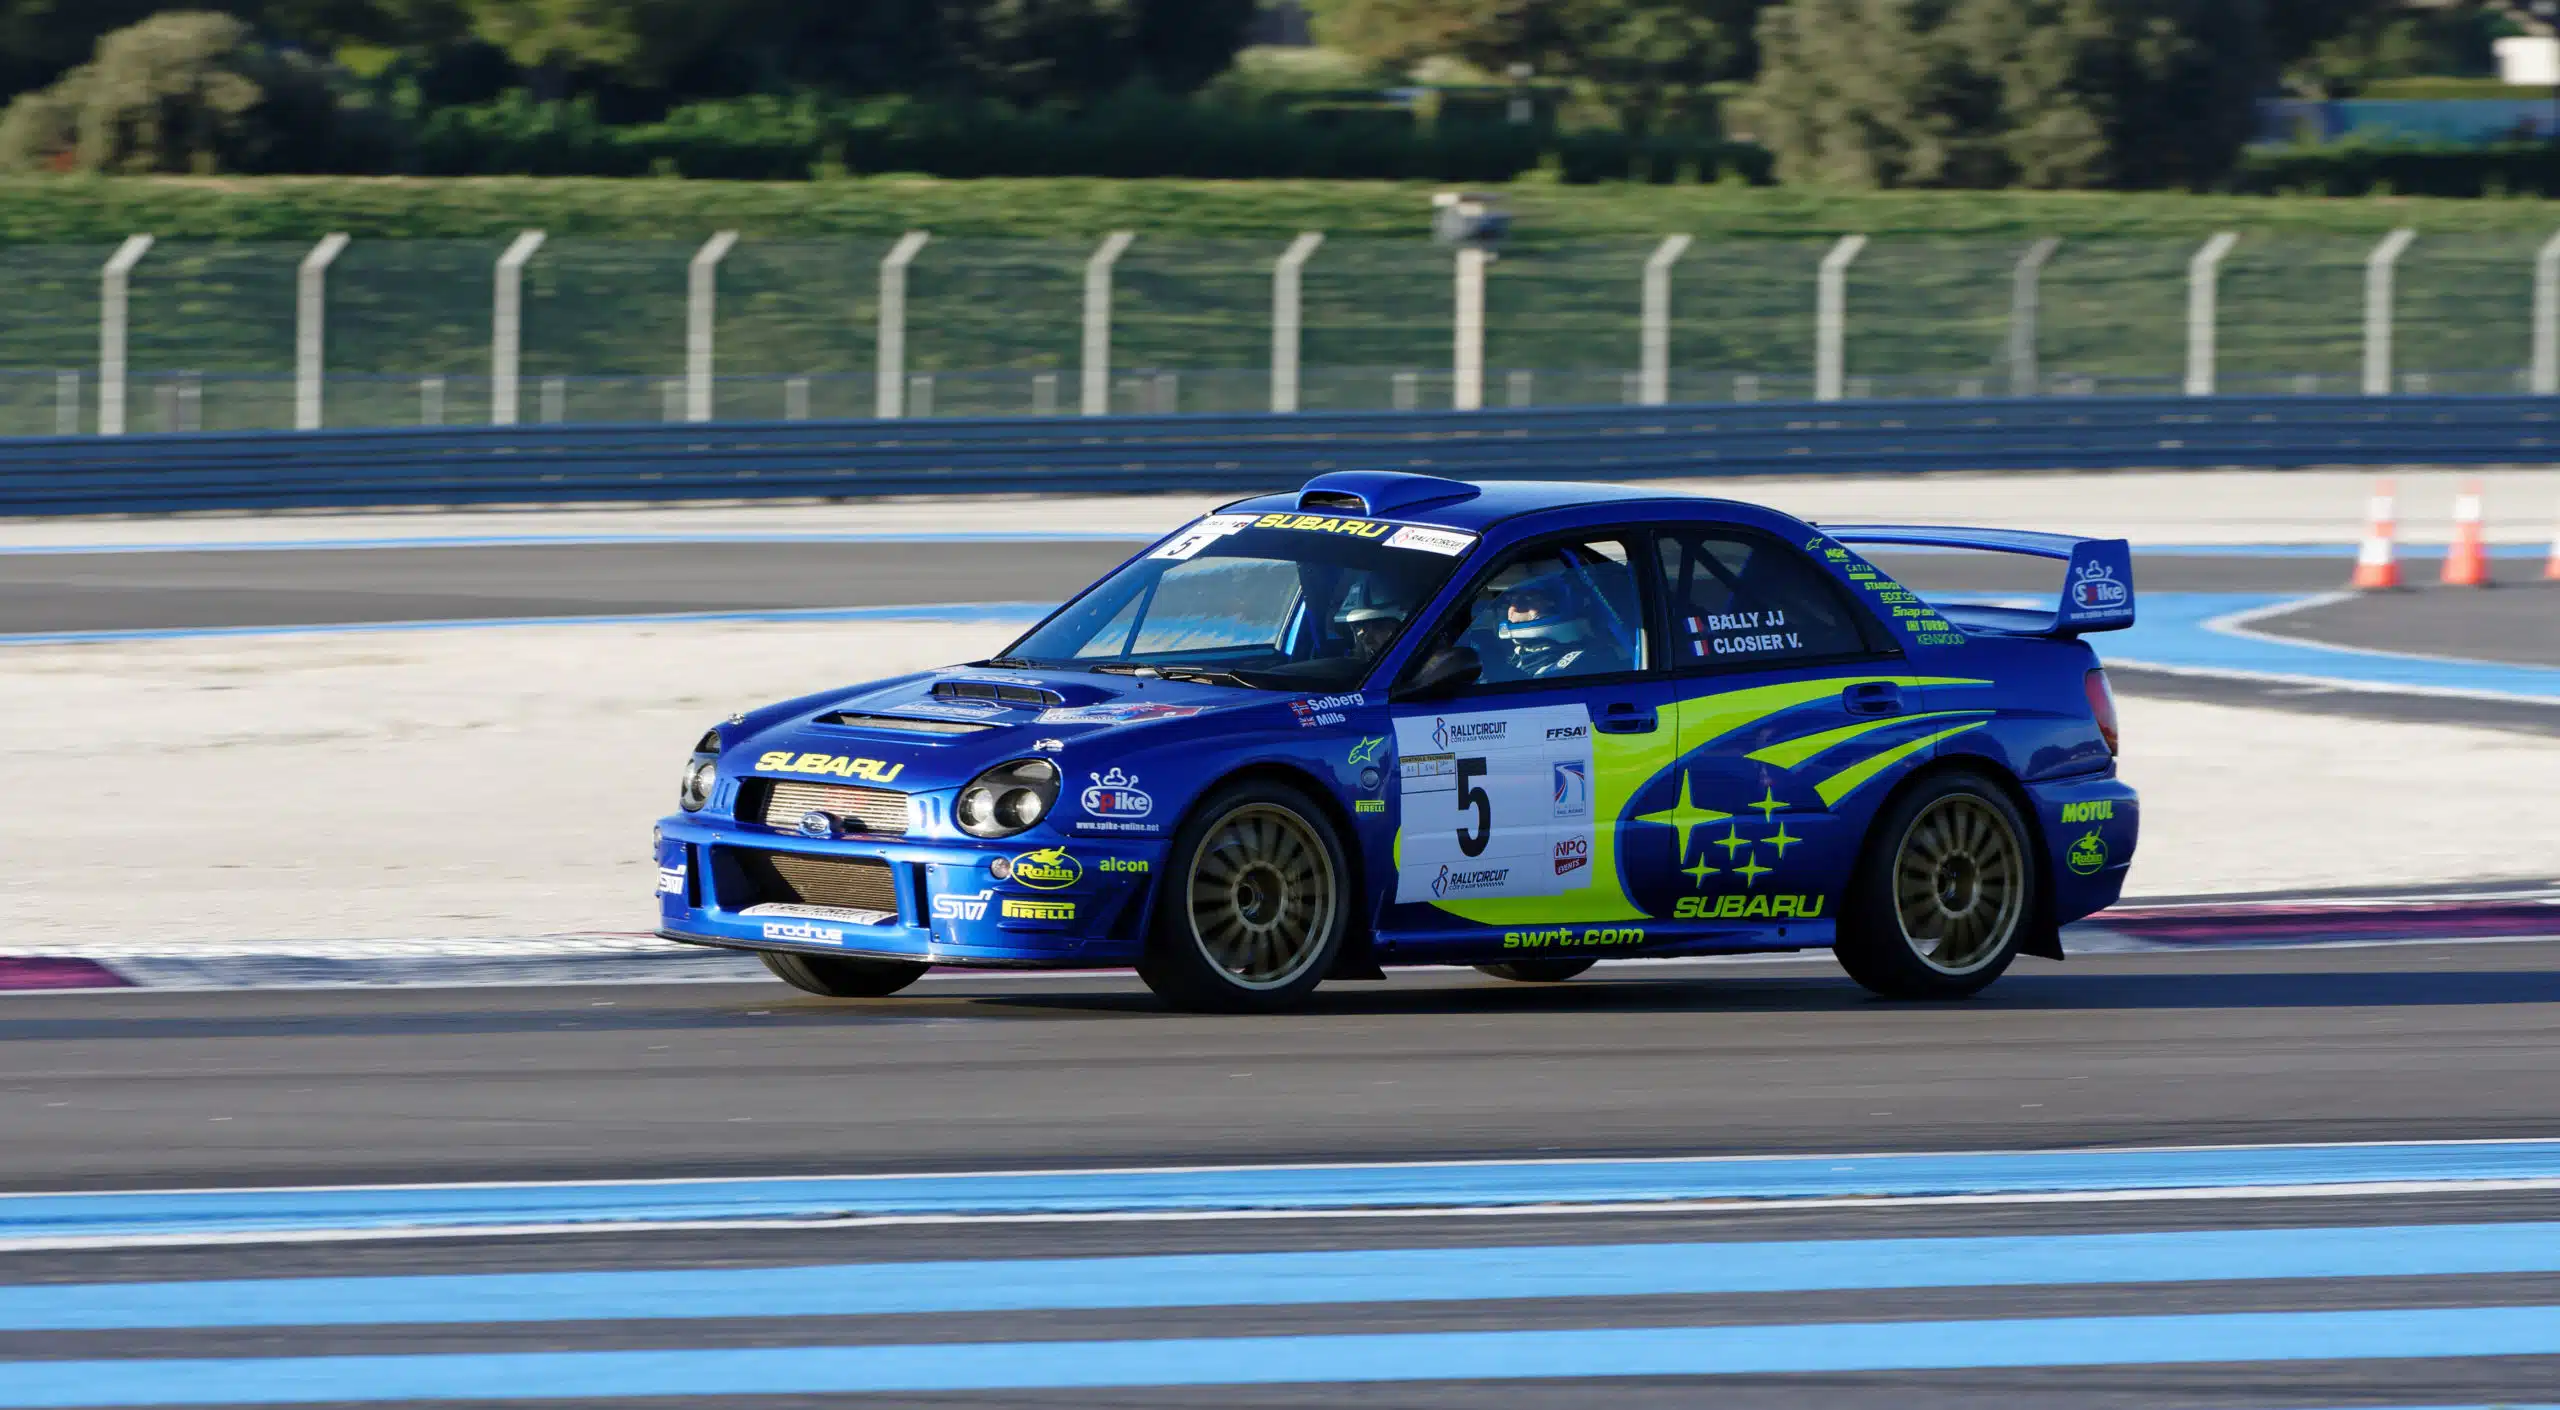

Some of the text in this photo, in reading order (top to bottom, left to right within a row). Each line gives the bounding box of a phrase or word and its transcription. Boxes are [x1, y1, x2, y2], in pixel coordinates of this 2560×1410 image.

[1254, 514, 1390, 538] SUBARU
[1167, 536, 1202, 556] 5
[1708, 610, 1785, 630] BALLY JJ
[1713, 633, 1803, 654] CLOSIER V.
[1917, 634, 1965, 645] KENWOOD
[1307, 693, 1365, 711] Solberg
[1316, 712, 1346, 726] Mills
[1451, 721, 1508, 737] RALLYCIRCUIT
[755, 751, 904, 783] SUBARU
[1087, 790, 1148, 813] Spike
[1456, 757, 1492, 857] 5
[2061, 800, 2114, 823] MOTUL
[1076, 821, 1159, 832] www.spike-online.net
[1556, 840, 1587, 856] NPO
[1018, 862, 1073, 880] Robin
[1100, 857, 1149, 872] alcon
[1450, 869, 1509, 885] RALLYCIRCUIT
[1002, 899, 1075, 919] PIRELLI
[1673, 894, 1825, 918] SUBARU
[1503, 926, 1645, 949] swrt.com
